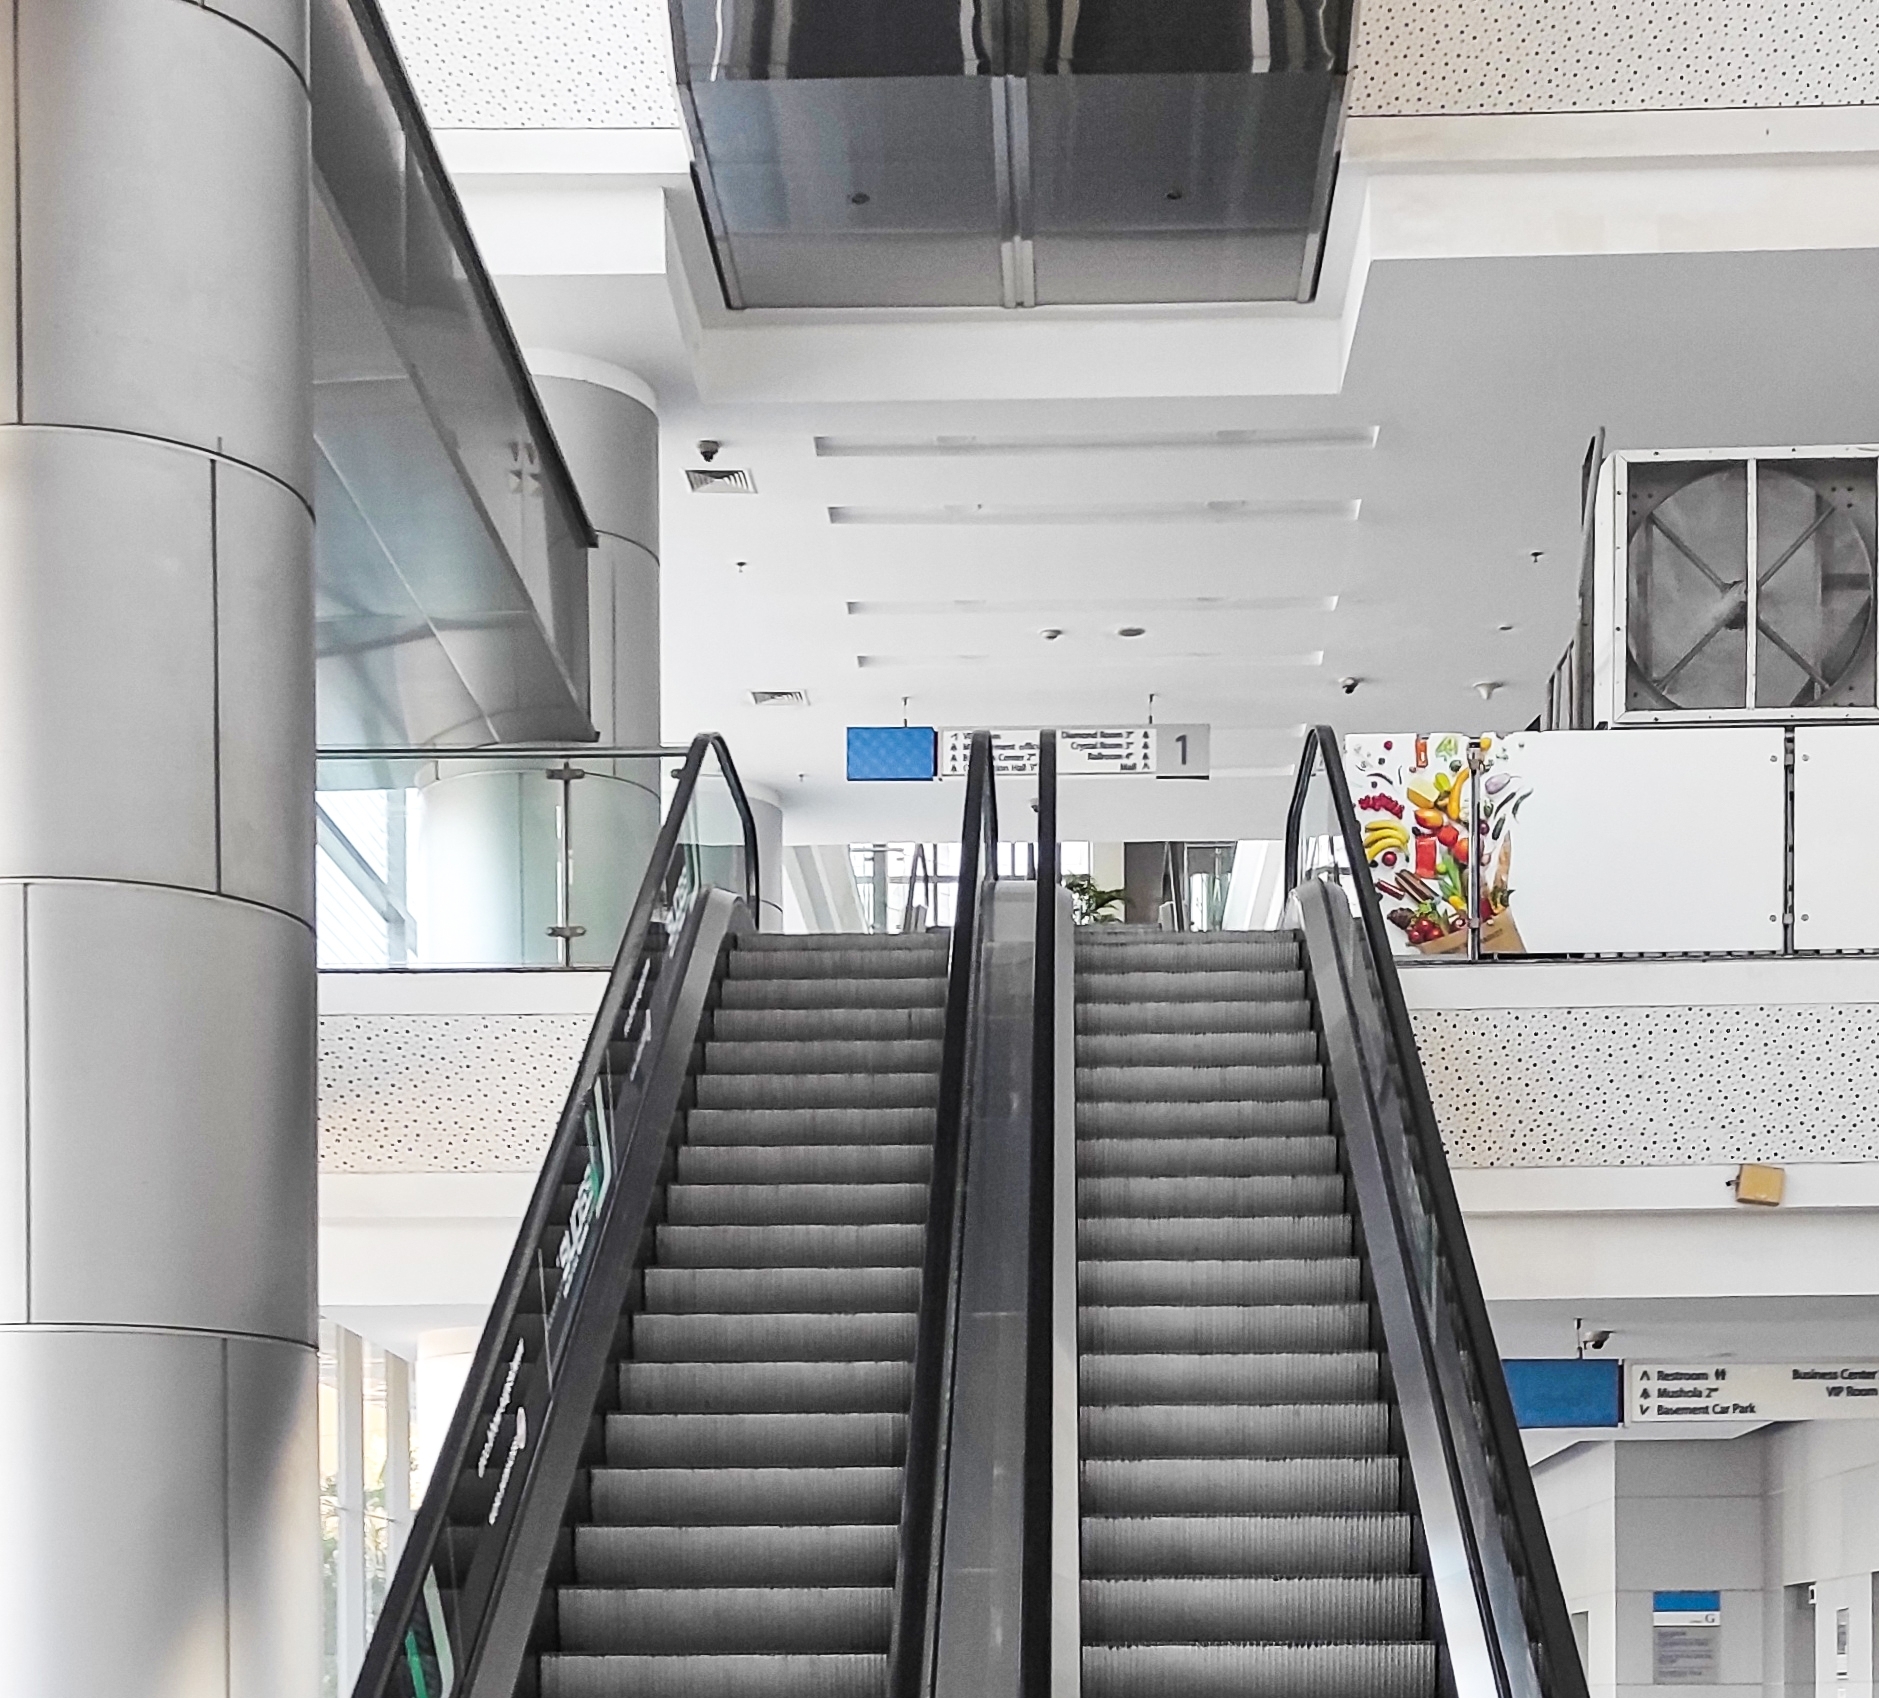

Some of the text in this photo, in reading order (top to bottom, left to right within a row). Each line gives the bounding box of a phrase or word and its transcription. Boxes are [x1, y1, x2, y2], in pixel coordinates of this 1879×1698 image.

[1061, 731, 1098, 739] Diamond
[1100, 731, 1123, 739] Room
[1175, 734, 1188, 766] 1
[1656, 1370, 1709, 1381] Restroom
[1791, 1368, 1877, 1380] Business Center
[1656, 1387, 1703, 1398] Mushola
[1845, 1386, 1878, 1397] Room
[1656, 1403, 1756, 1415] Basement Car Park
